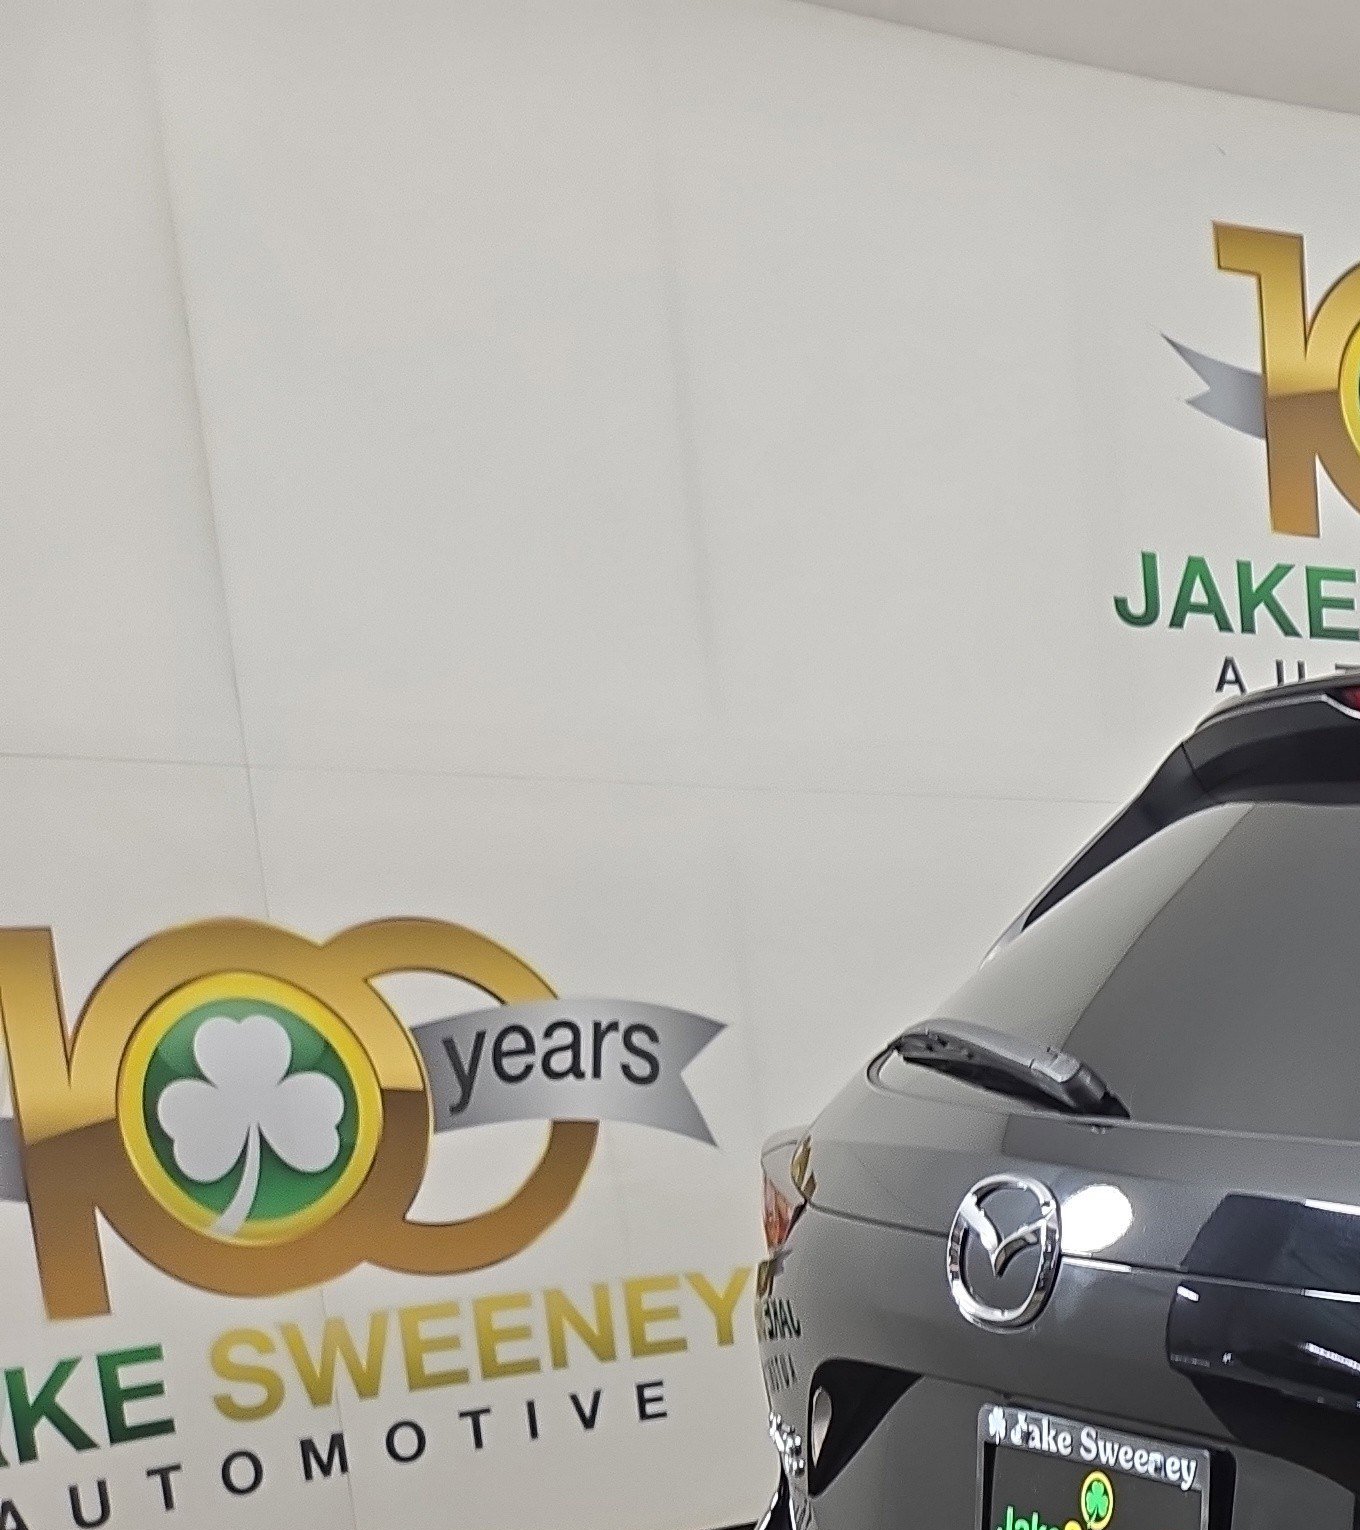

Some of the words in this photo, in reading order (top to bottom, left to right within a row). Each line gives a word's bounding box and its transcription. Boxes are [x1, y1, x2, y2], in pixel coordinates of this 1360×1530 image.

[442, 1018, 661, 1115] years
[0, 1342, 176, 1468] KE
[209, 1265, 752, 1424] SWEENEY
[1010, 1411, 1073, 1456] Jake
[1079, 1426, 1197, 1490] Sweeney
